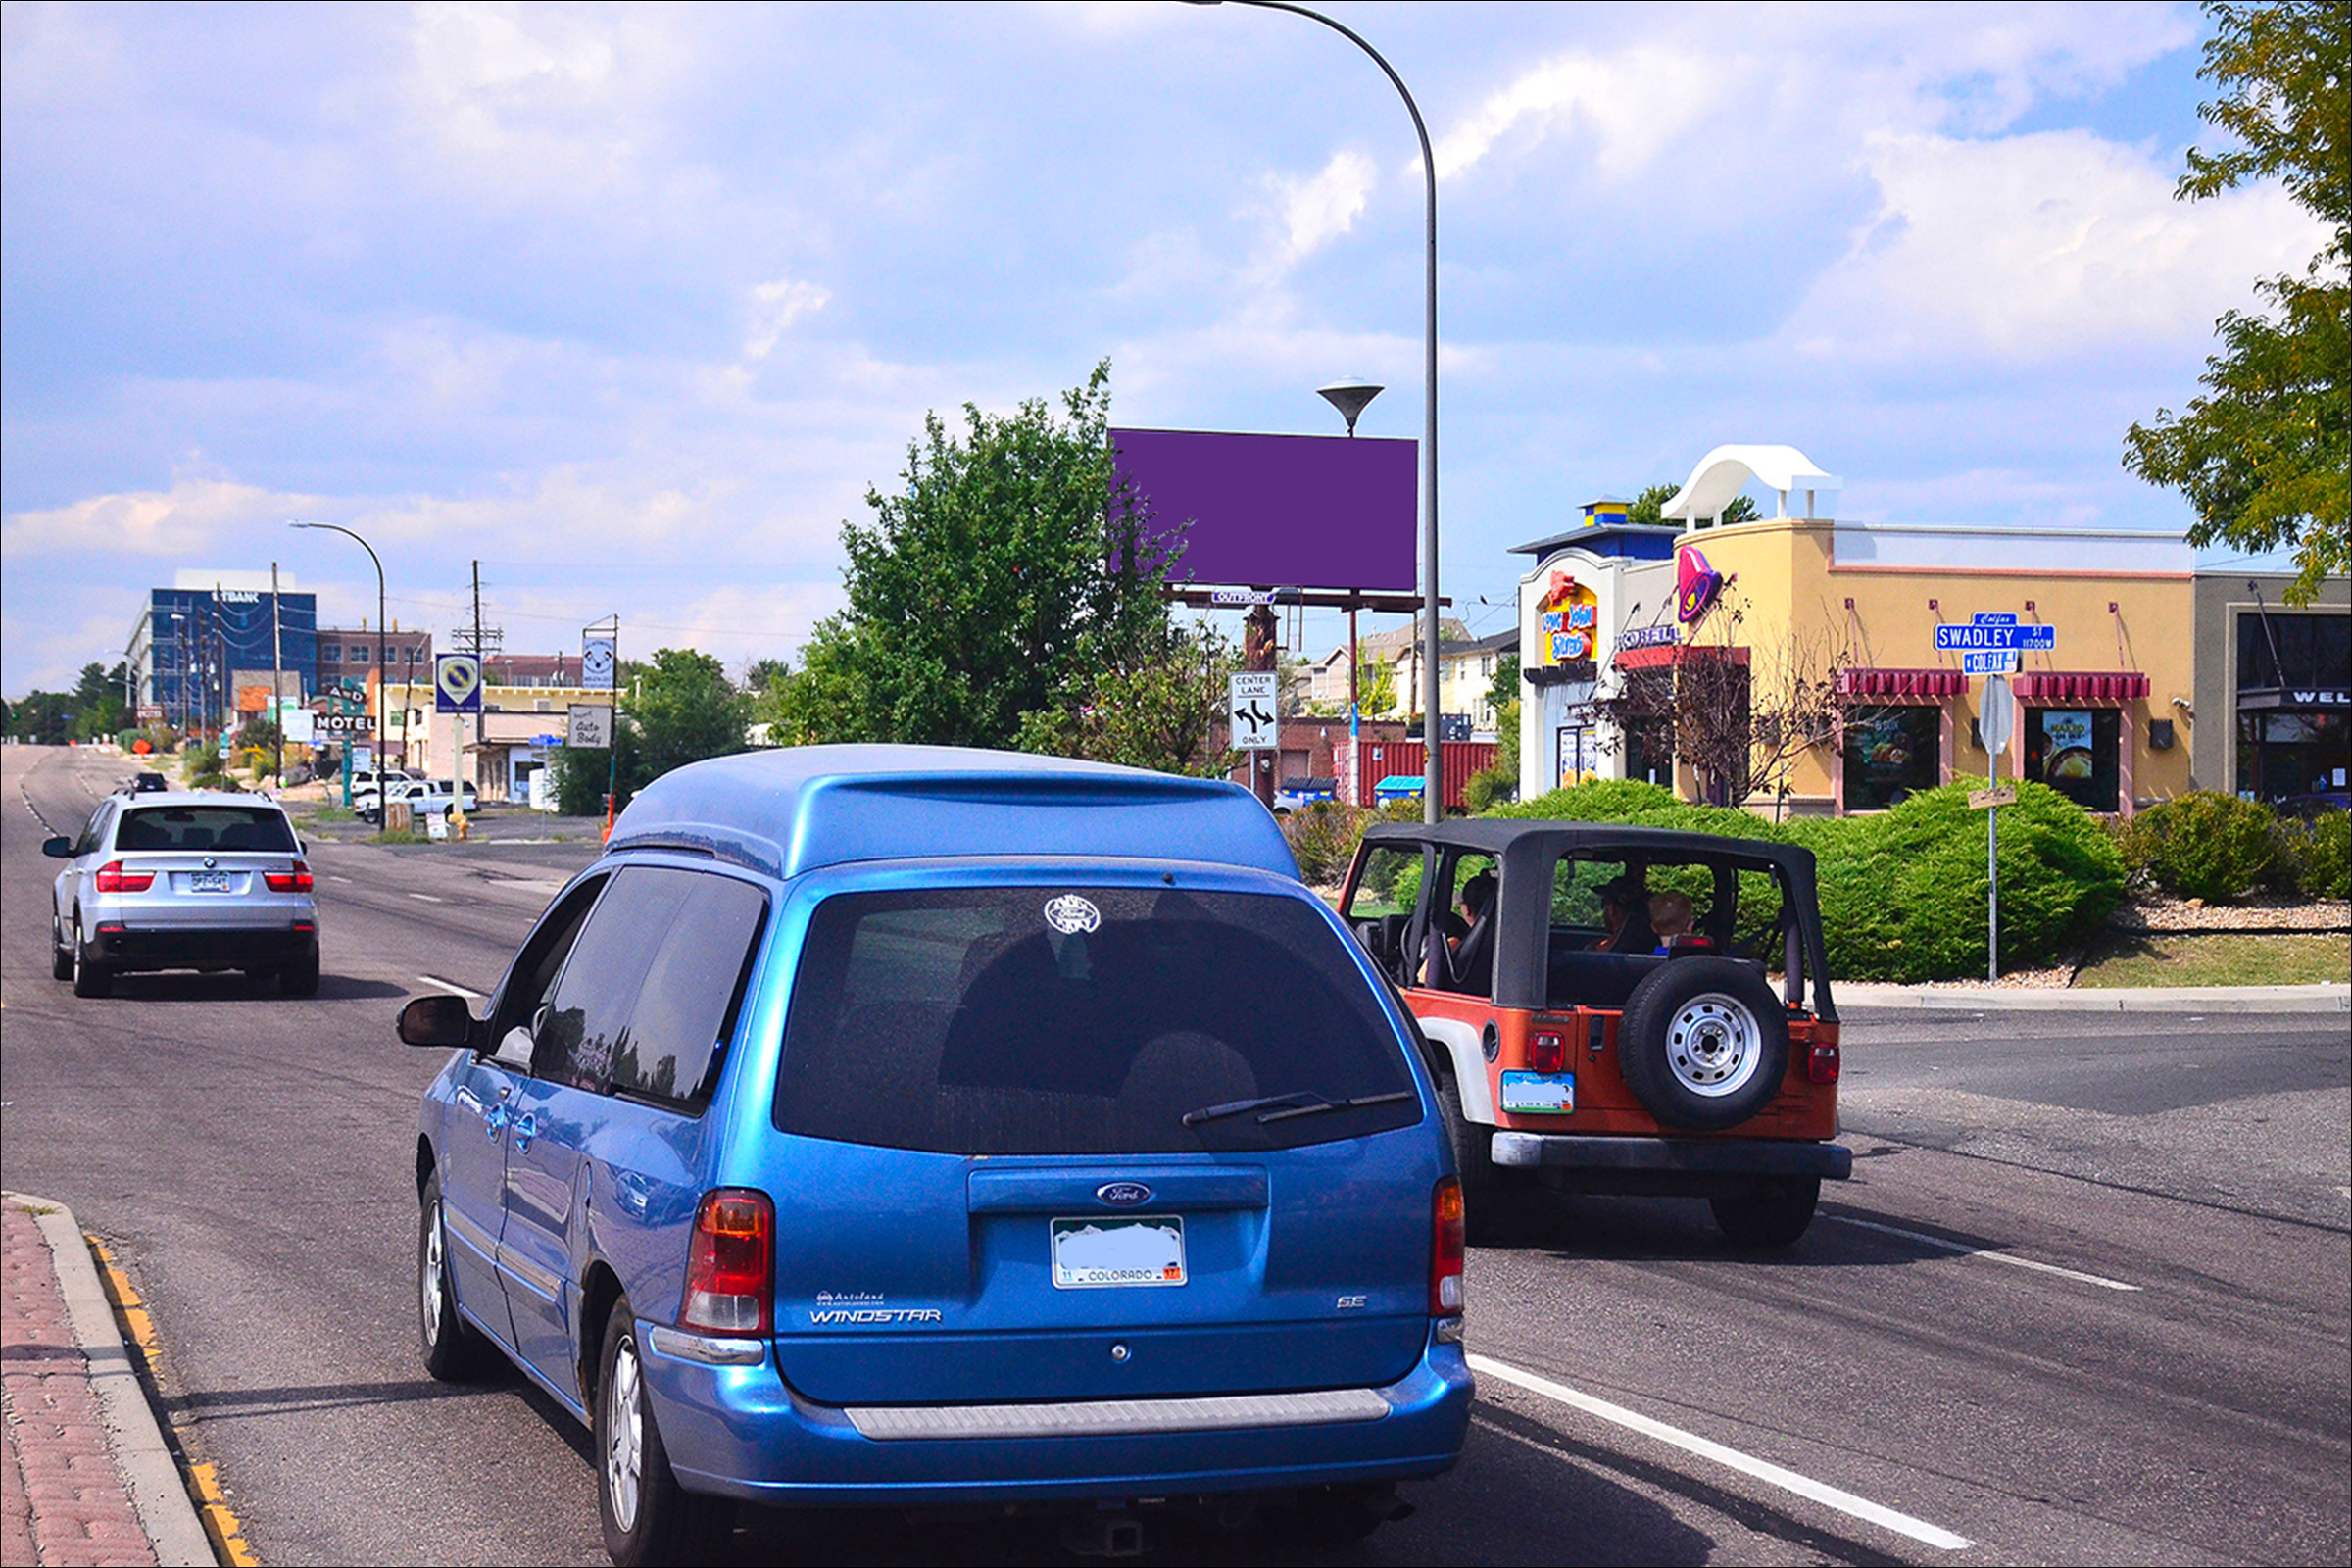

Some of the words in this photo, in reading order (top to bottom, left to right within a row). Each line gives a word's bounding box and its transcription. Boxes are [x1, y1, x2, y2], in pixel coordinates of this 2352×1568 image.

[1219, 591, 1269, 603] OUTFRONT
[1568, 604, 1592, 629] JOHN
[1938, 628, 2014, 647] SWADLEY
[2033, 627, 2042, 637] ST
[1235, 676, 1272, 685] CENTER
[317, 716, 376, 730] MOTEL
[576, 731, 602, 746] Body
[1241, 736, 1268, 745] ONLY
[1109, 1188, 1140, 1201] Ford
[1088, 1270, 1152, 1282] COLORADO
[1337, 1295, 1368, 1309] SE
[809, 1309, 942, 1323] WINDSTAR
